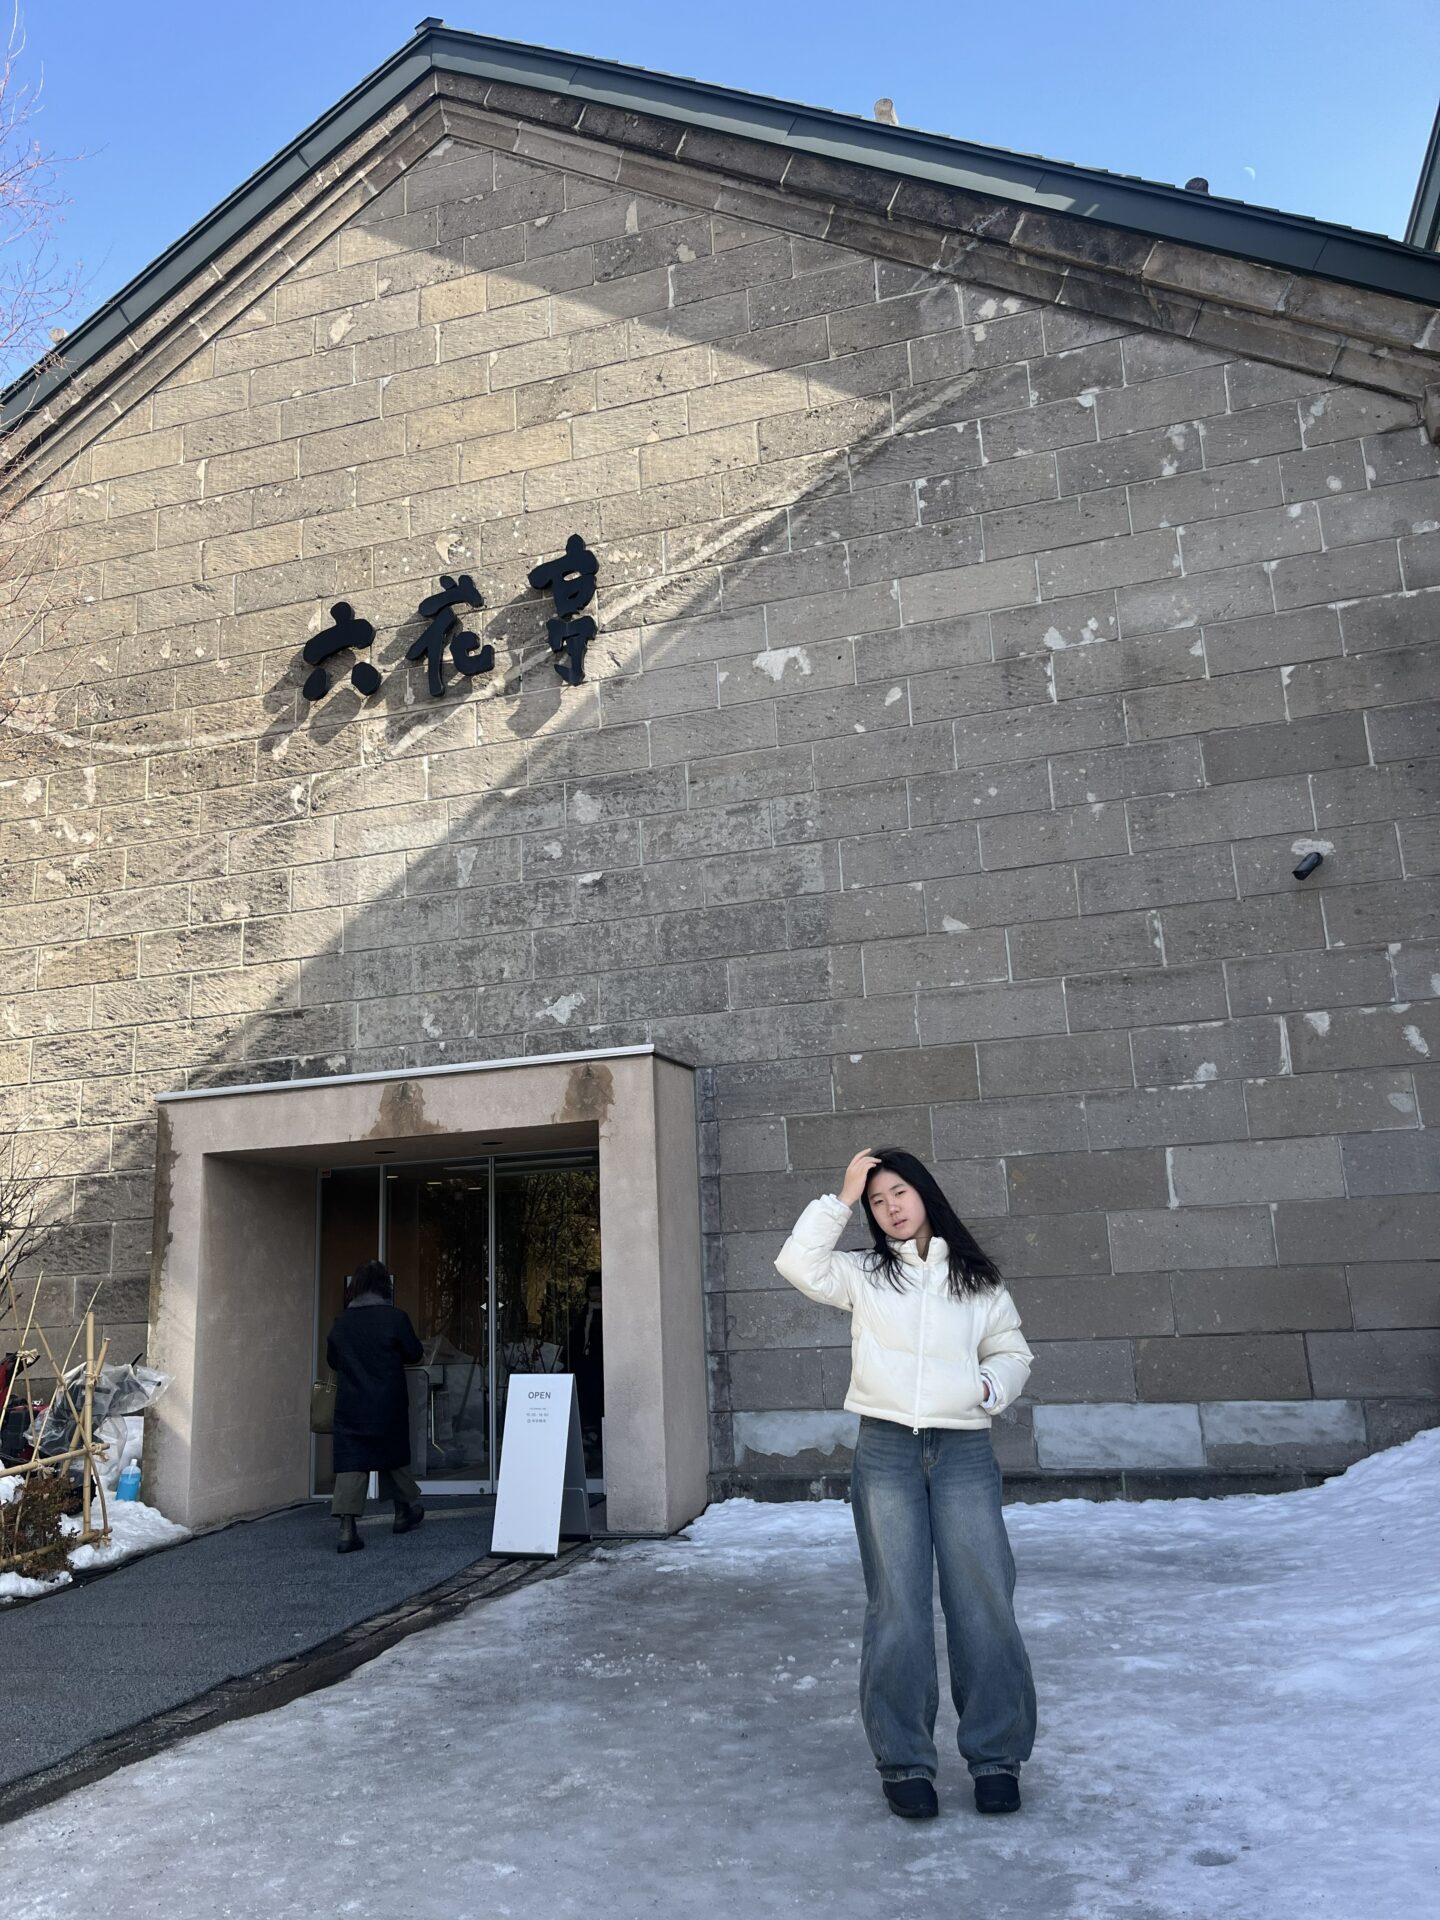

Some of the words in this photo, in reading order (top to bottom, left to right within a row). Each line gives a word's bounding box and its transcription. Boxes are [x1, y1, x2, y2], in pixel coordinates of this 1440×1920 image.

[303, 533, 600, 701] 六花亭
[528, 1391, 551, 1399] OPEN
